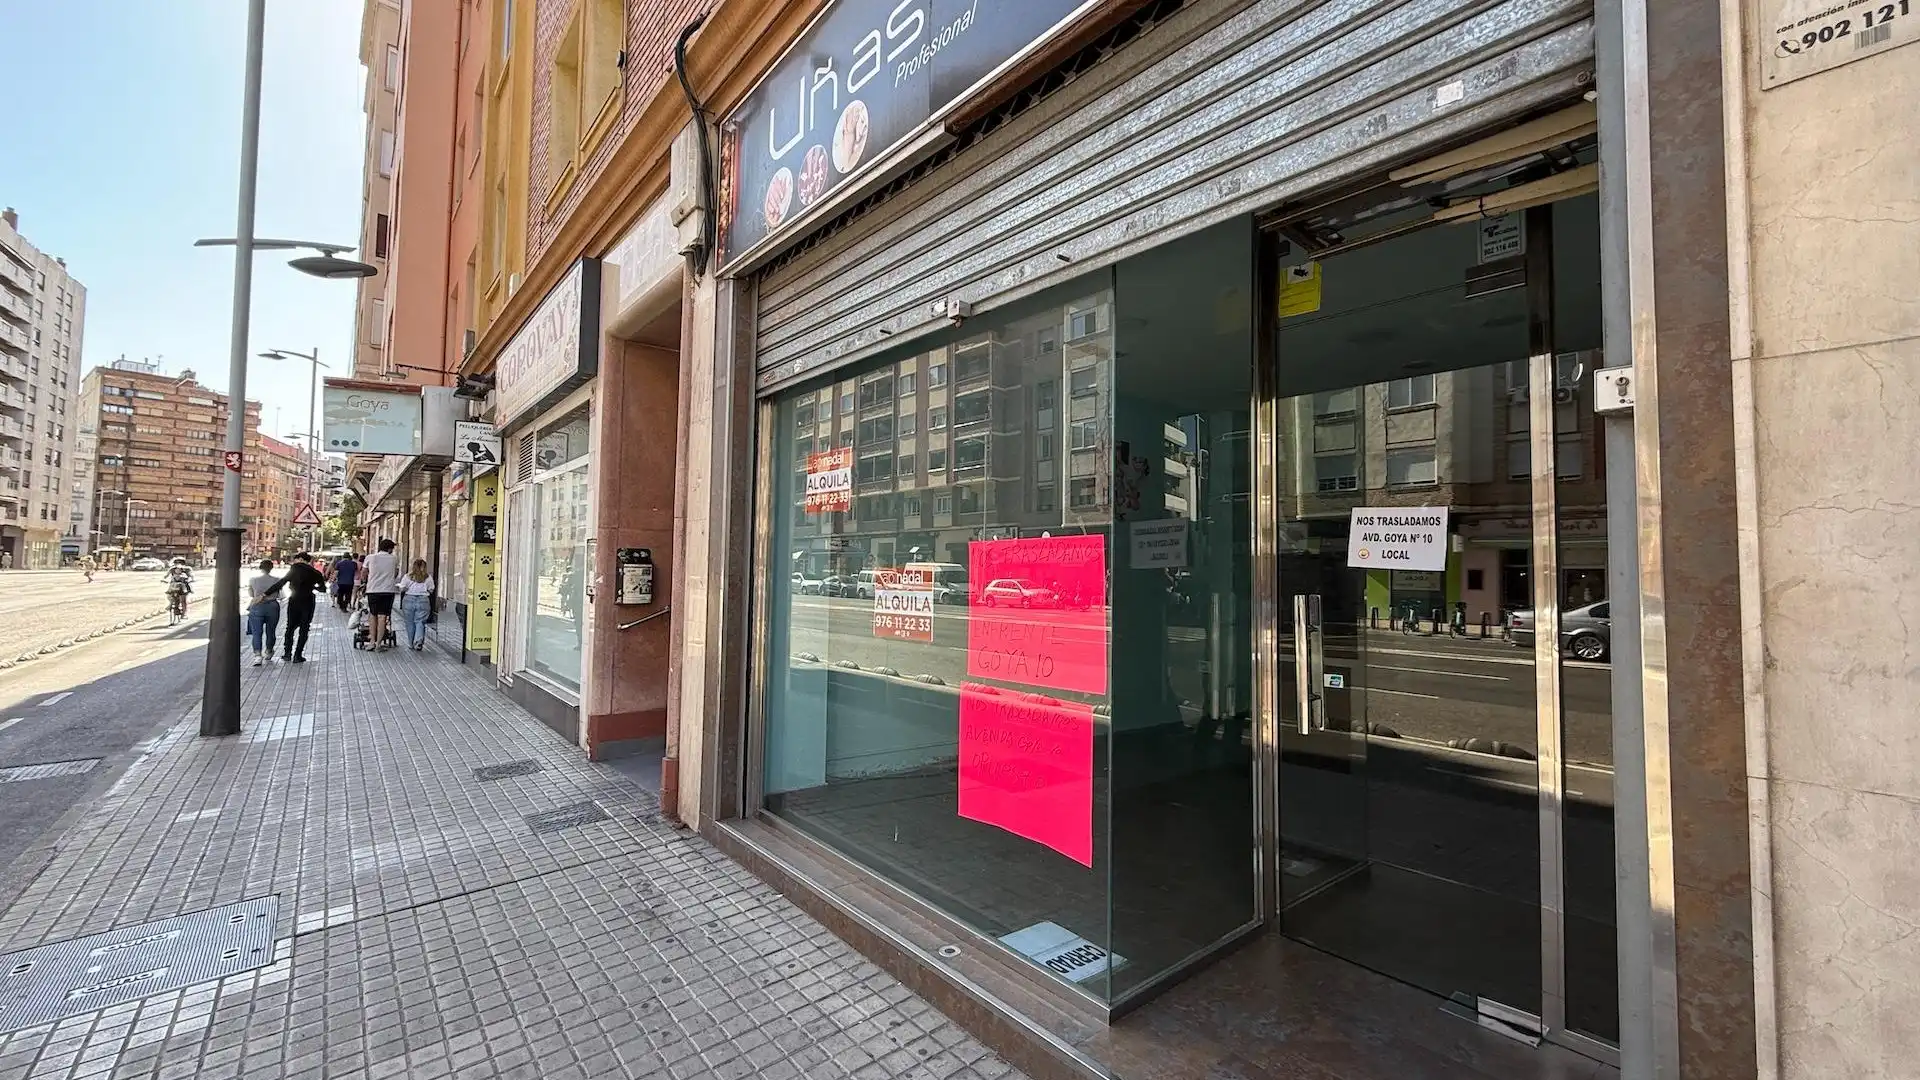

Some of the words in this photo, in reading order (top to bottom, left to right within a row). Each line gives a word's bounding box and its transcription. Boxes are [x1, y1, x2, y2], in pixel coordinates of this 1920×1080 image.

[1776, 23, 1794, 34] con
[1797, 5, 1844, 27] atención
[1802, 19, 1851, 49] 902
[1862, 0, 1909, 28] 121
[895, 0, 978, 88] Profesional
[347, 394, 391, 413] Goya
[807, 472, 849, 491] ALQUILA
[807, 494, 820, 506] 976
[1357, 516, 1374, 525] NOS
[1376, 516, 1441, 526] TRASLADAMOS
[1362, 533, 1381, 542] AVD.
[1384, 533, 1408, 543] GOYA
[1423, 534, 1433, 543] 10
[1001, 541, 1102, 564] TRASLADAMOS
[1381, 550, 1410, 560] LOCAL
[876, 594, 931, 612] ALQUILA
[875, 615, 892, 628] 976
[895, 617, 902, 629] 11
[904, 617, 916, 630] 22
[918, 618, 930, 632] 33
[973, 620, 1065, 645] ENFRENTE
[977, 644, 1029, 677] GOYA
[1035, 652, 1055, 678] 10
